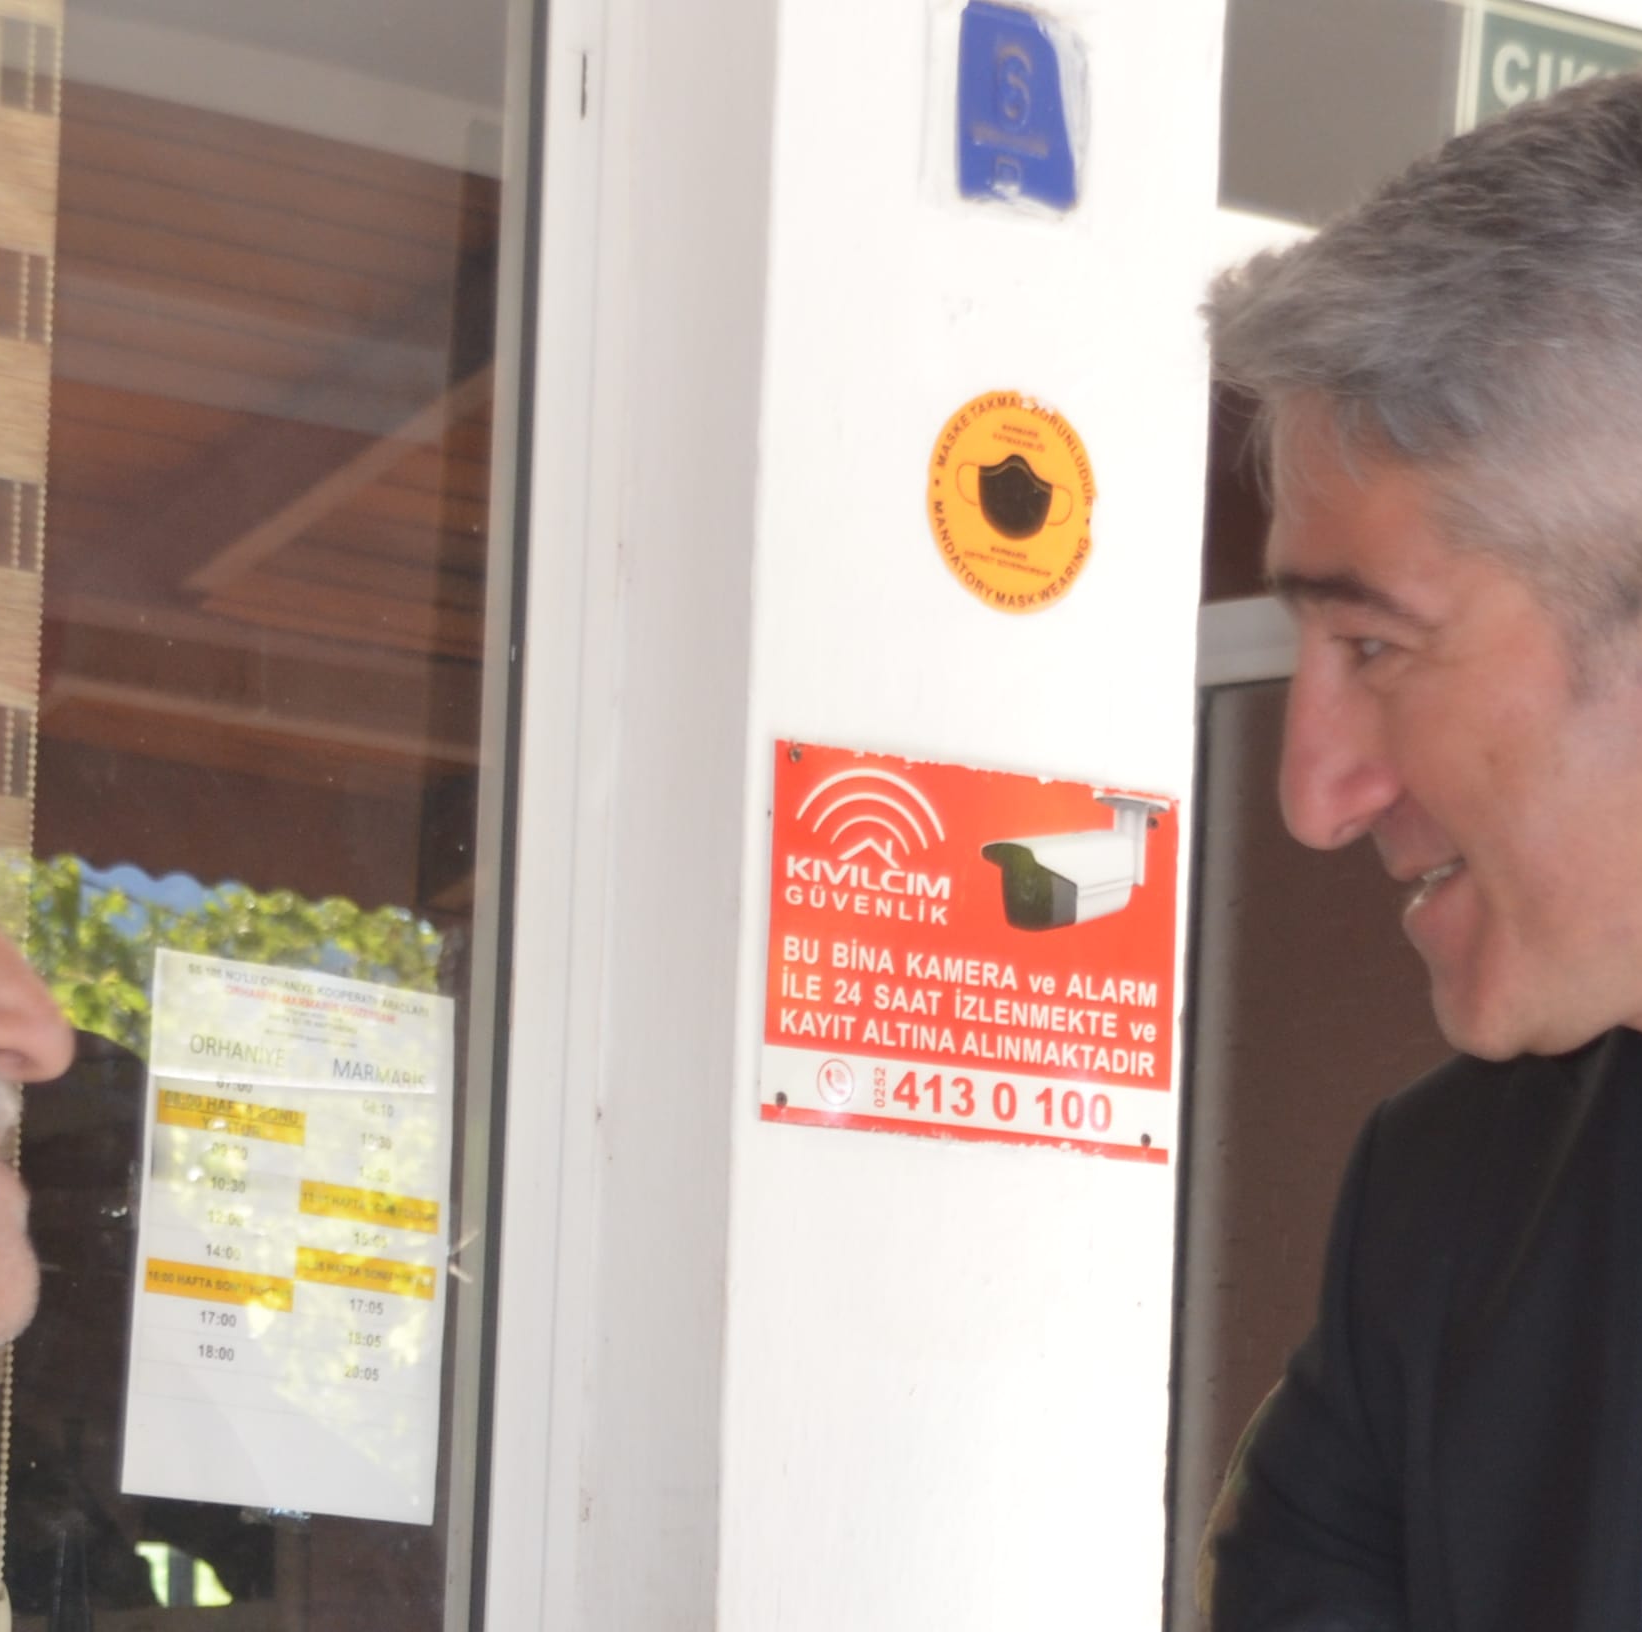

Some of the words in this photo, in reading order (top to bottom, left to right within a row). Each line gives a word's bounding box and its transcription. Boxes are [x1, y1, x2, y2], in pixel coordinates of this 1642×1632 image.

[936, 414, 971, 467] MASKE
[934, 500, 994, 598] MANDATORY
[995, 590, 1037, 609] MASK
[1038, 537, 1090, 602] WEARING
[786, 855, 951, 900] KIVILCIM
[785, 884, 948, 926] GÜVENLİK
[783, 935, 819, 965] BU
[832, 939, 895, 975] BİNA
[907, 952, 1018, 991] KAMERA
[1028, 974, 1056, 995] ve
[1066, 973, 1157, 1008] ALARM
[781, 965, 821, 1002] İLE
[833, 978, 862, 1007] 24
[873, 983, 942, 1016] SAAT
[954, 987, 1118, 1039] İZLENMEKTE
[1129, 1021, 1157, 1043] ve
[780, 1007, 856, 1042] KAYIT
[862, 1018, 956, 1054] ALTINA
[961, 1030, 1154, 1078] ALINMAKTADIR
[873, 1067, 887, 1109] 0252
[892, 1071, 976, 1118] 413
[991, 1081, 1017, 1122] 0
[1035, 1086, 1113, 1133] 100
[200, 1310, 237, 1328] 17:00
[198, 1343, 235, 1362] 18:00
